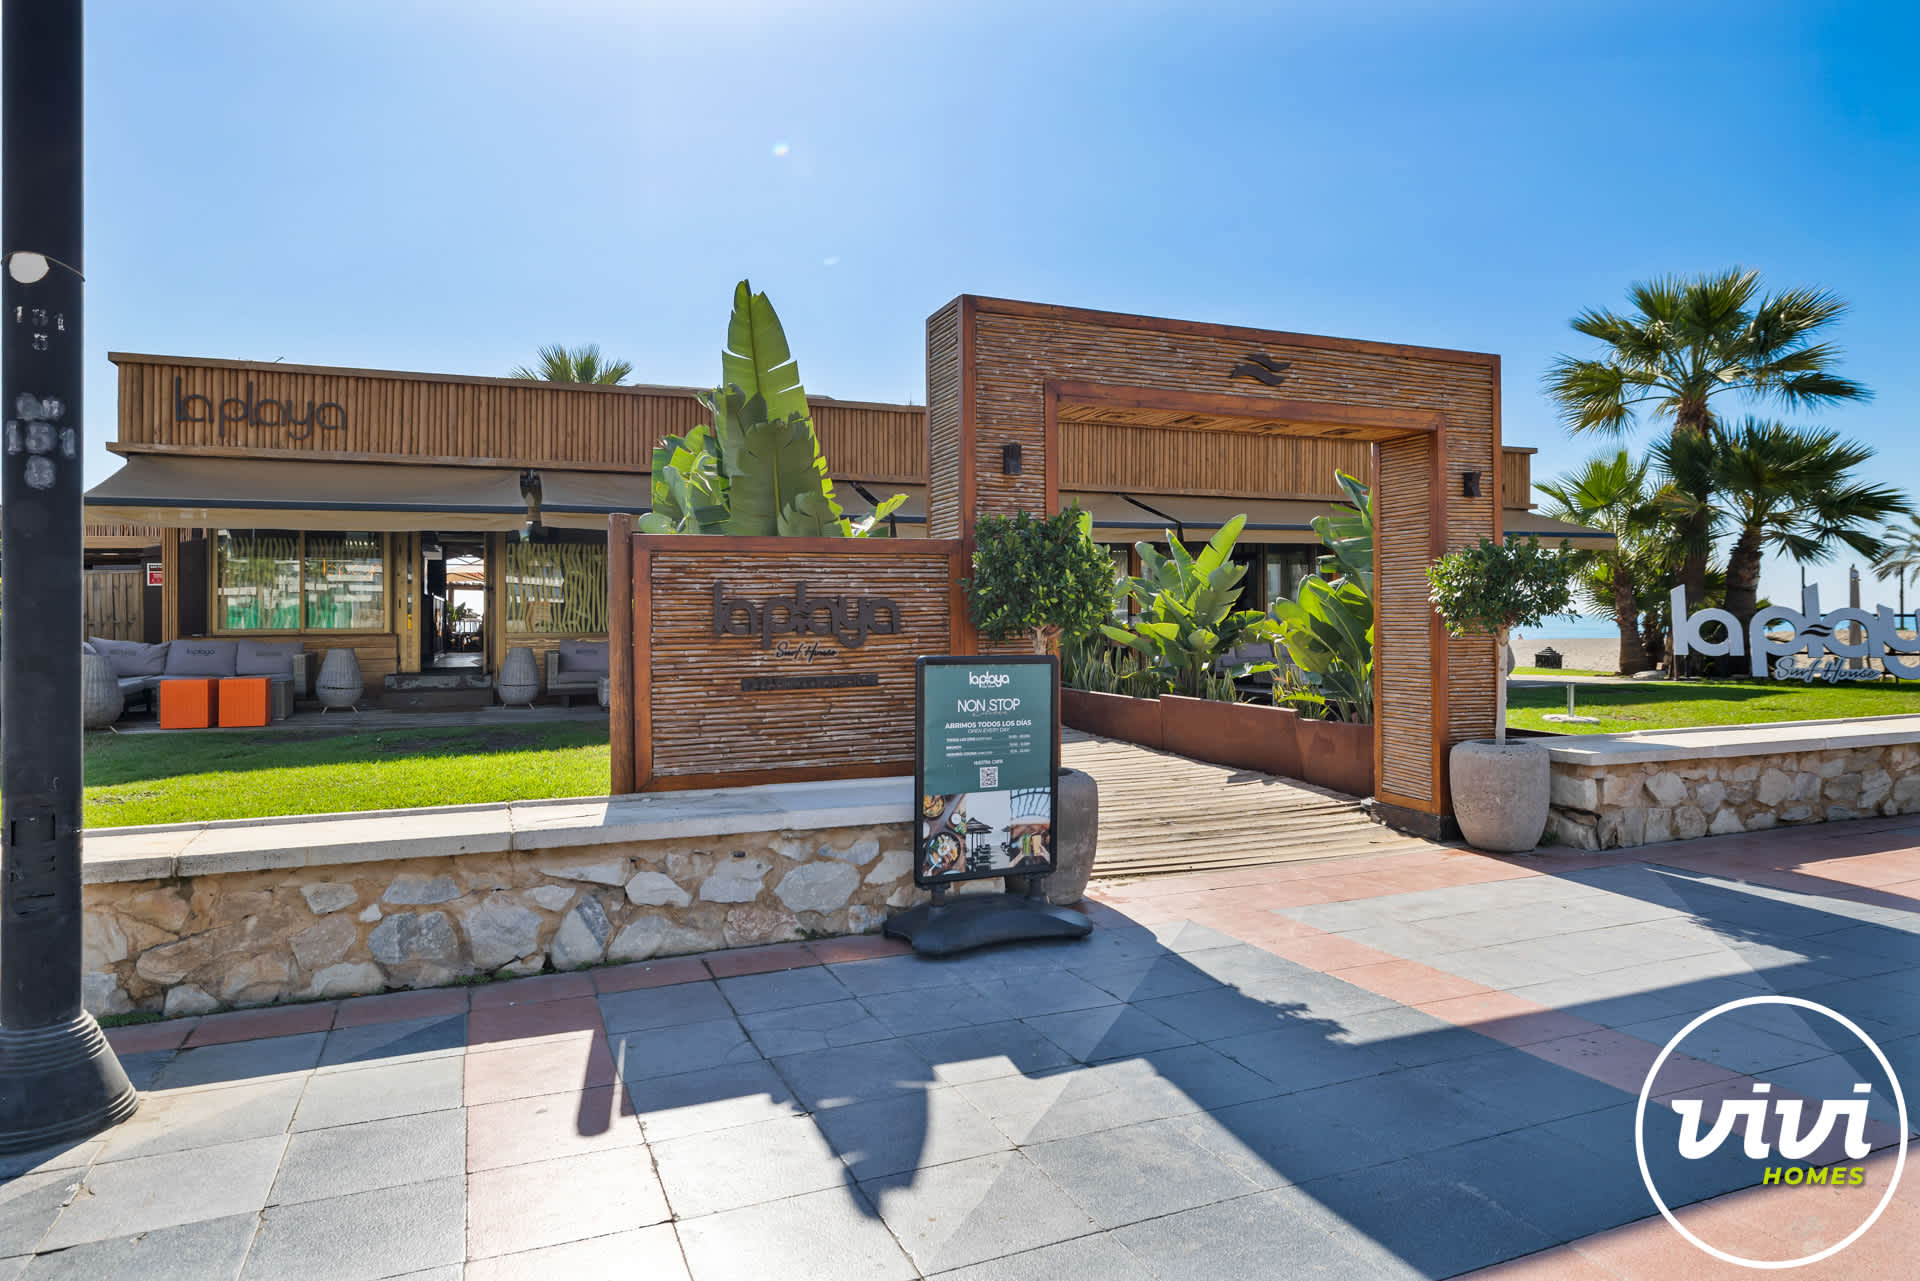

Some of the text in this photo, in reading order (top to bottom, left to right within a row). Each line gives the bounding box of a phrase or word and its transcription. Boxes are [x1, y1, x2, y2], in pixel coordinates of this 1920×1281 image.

[776, 641, 804, 660] Surf
[1776, 656, 1880, 682] Surf House
[957, 698, 1021, 713] NON STOP
[977, 720, 1001, 728] TODOS
[1016, 718, 1032, 726] DÍAS
